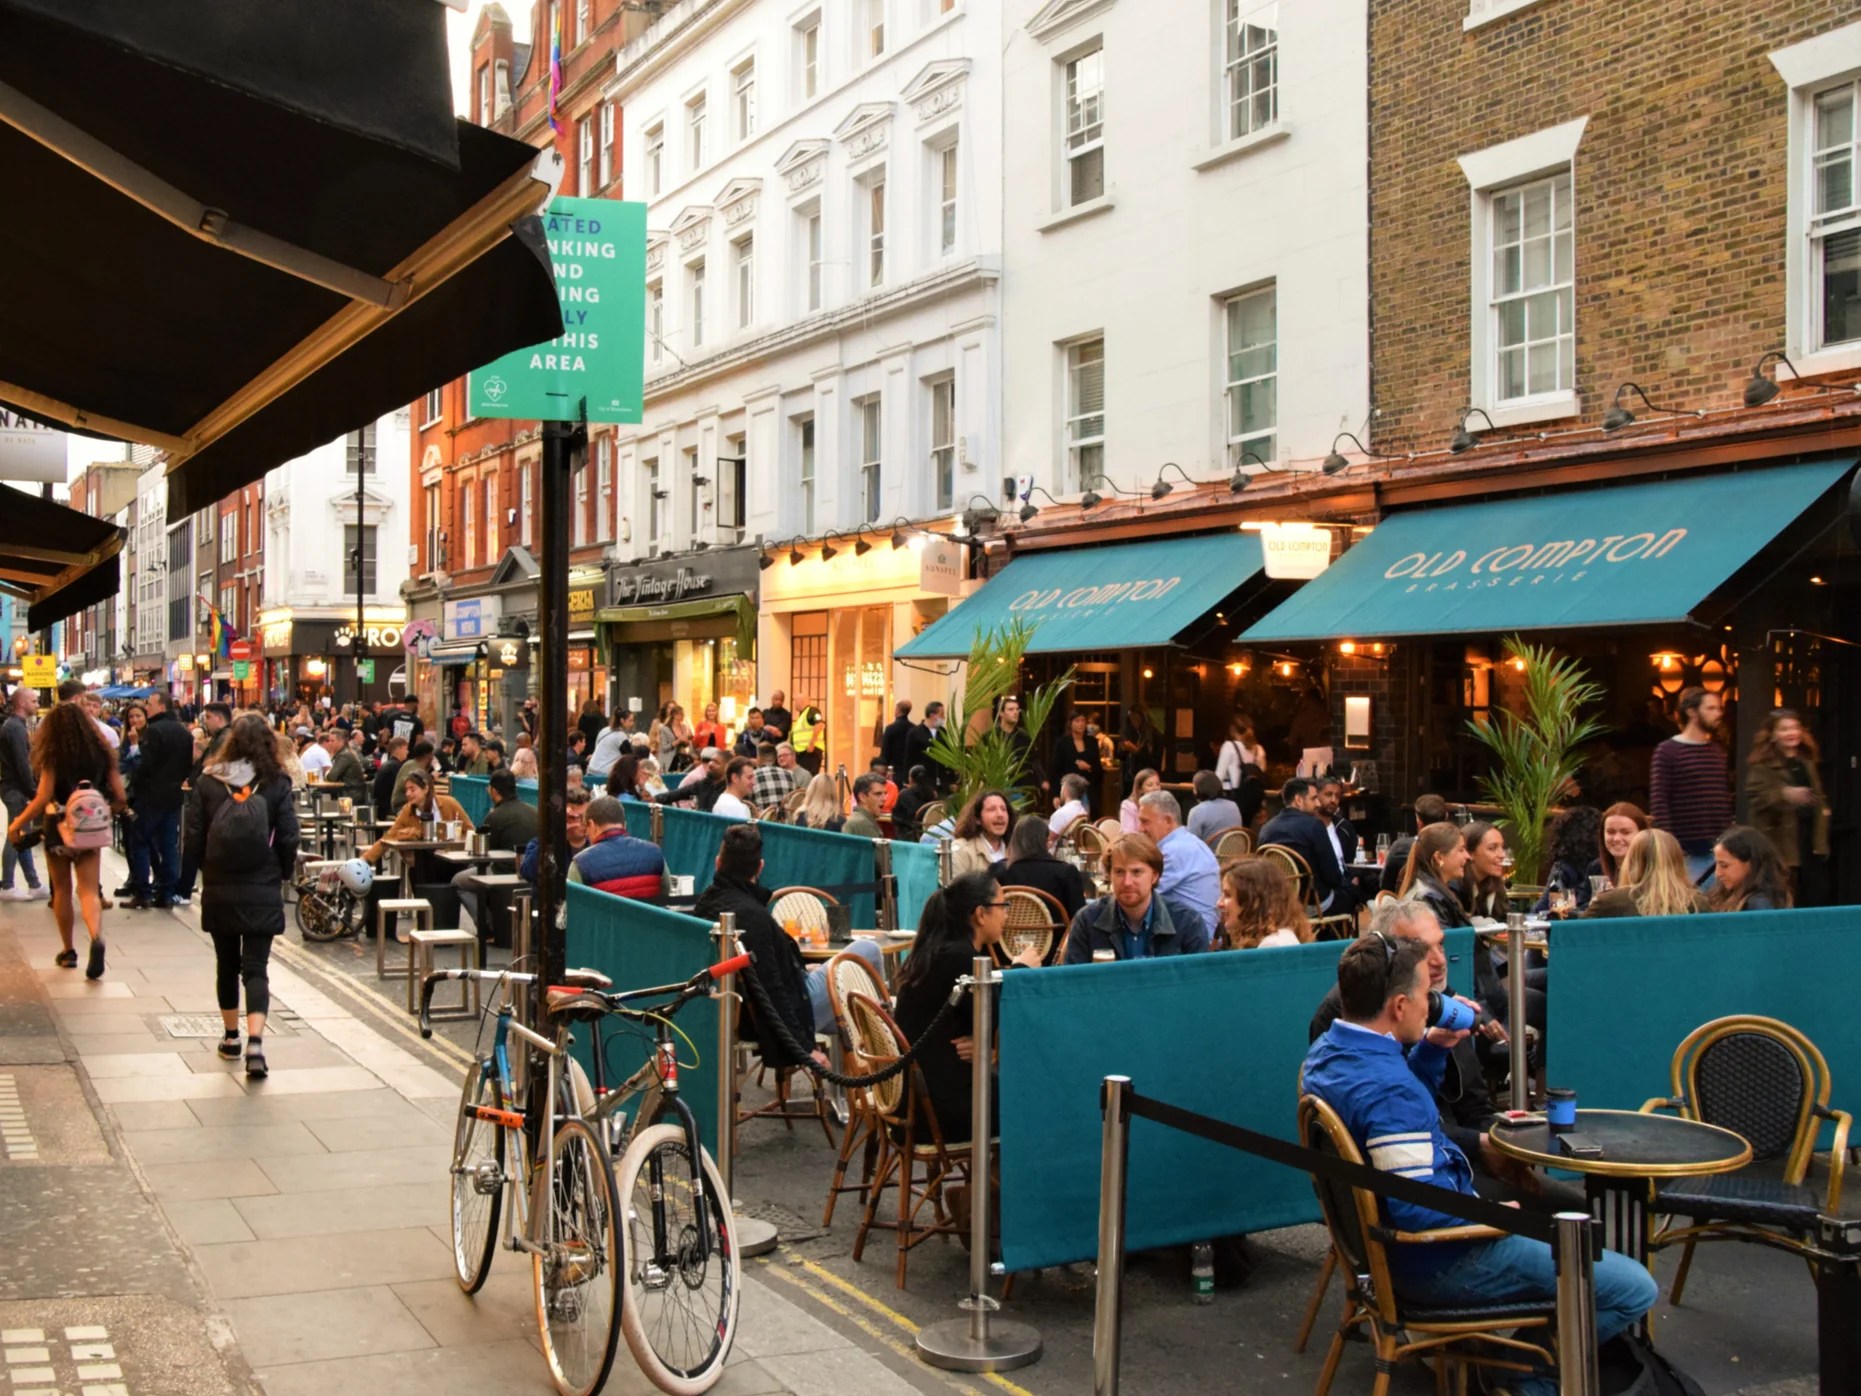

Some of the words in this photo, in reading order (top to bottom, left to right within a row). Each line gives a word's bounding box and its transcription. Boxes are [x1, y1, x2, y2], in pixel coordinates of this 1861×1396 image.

[529, 353, 586, 371] AREA
[1384, 550, 1467, 579] OLD
[1471, 528, 1688, 574] COMPTON
[615, 577, 636, 605] The
[635, 574, 677, 603] Vintage
[674, 568, 712, 599] House
[1009, 588, 1062, 611] OLD
[1057, 576, 1181, 609] COMPTON
[1404, 570, 1588, 593] BRASSERIE
